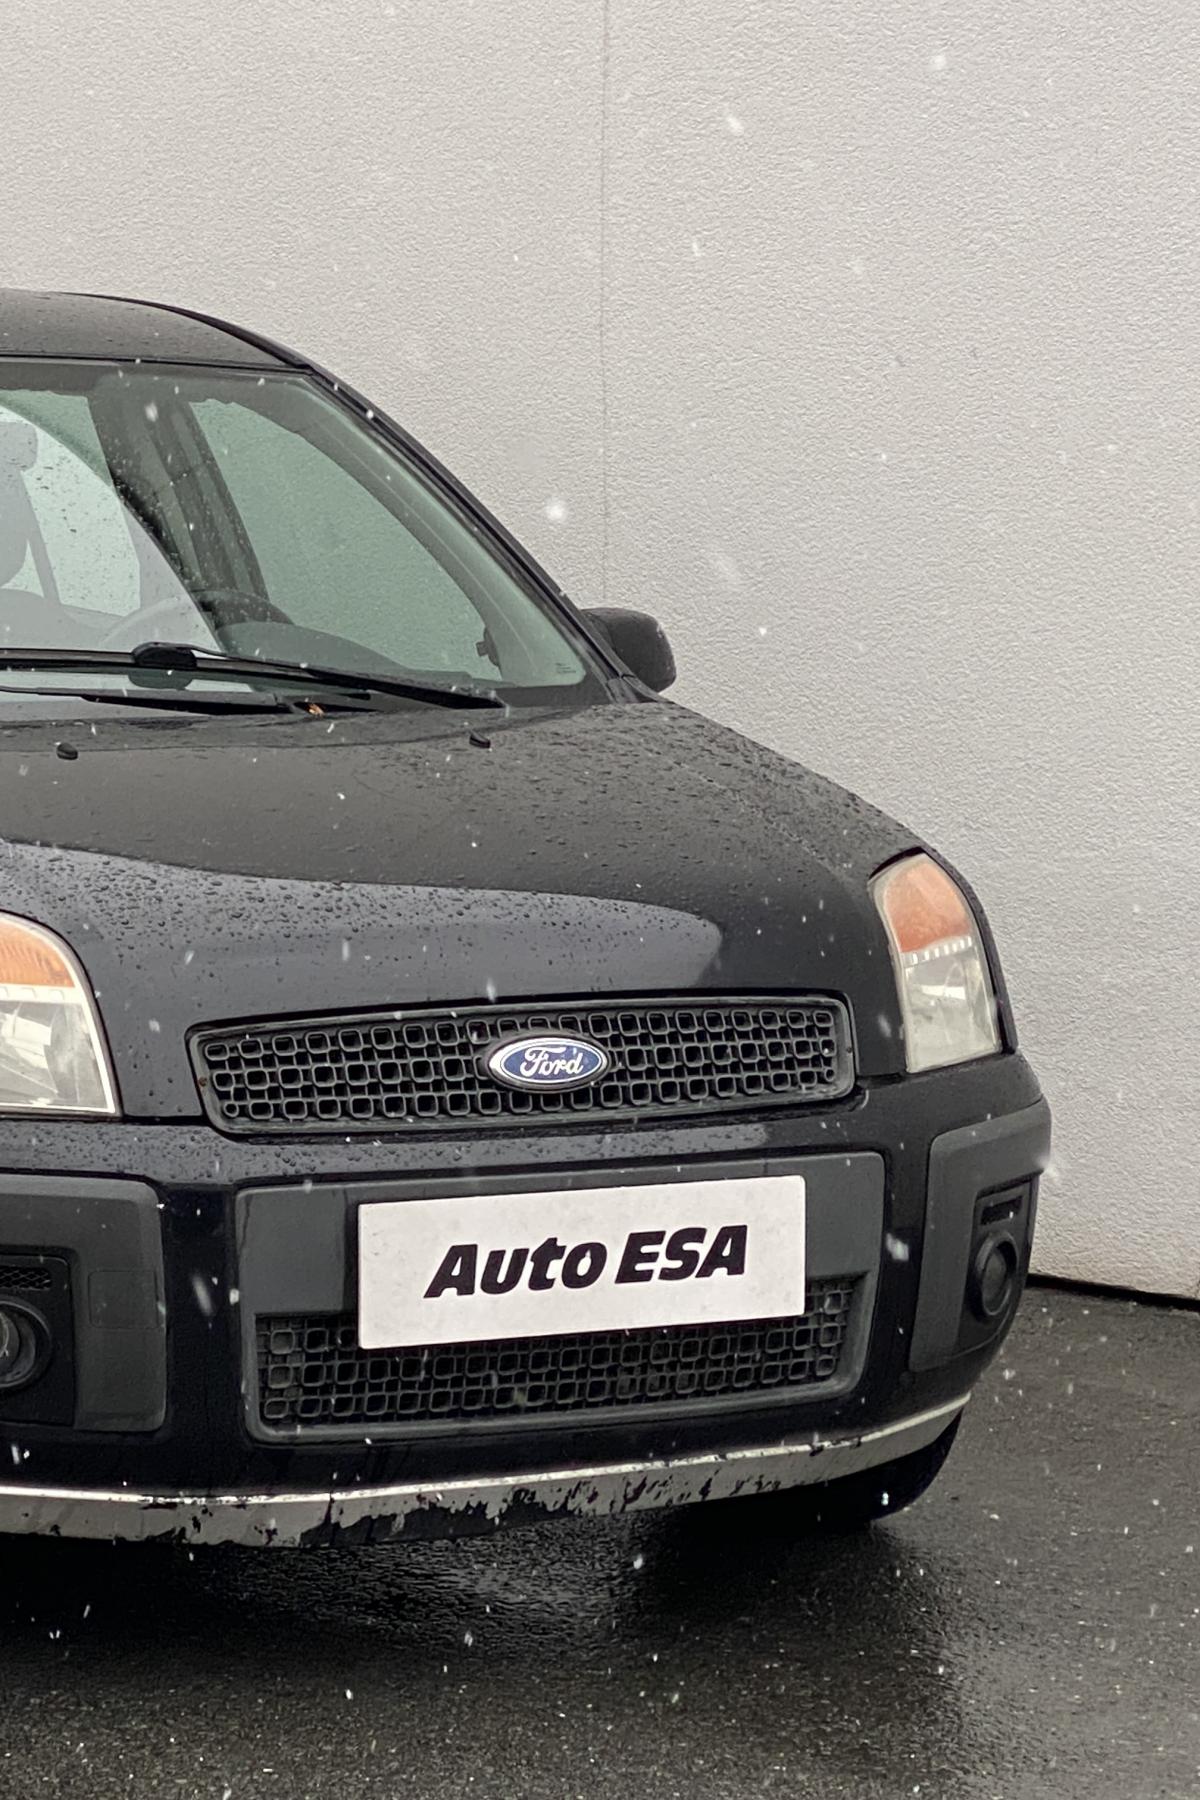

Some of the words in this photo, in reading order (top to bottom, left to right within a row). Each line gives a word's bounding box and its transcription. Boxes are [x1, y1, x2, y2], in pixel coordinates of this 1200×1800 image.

[519, 1046, 584, 1077] Ford
[423, 1237, 608, 1299] Auto
[614, 1224, 748, 1284] ESA
